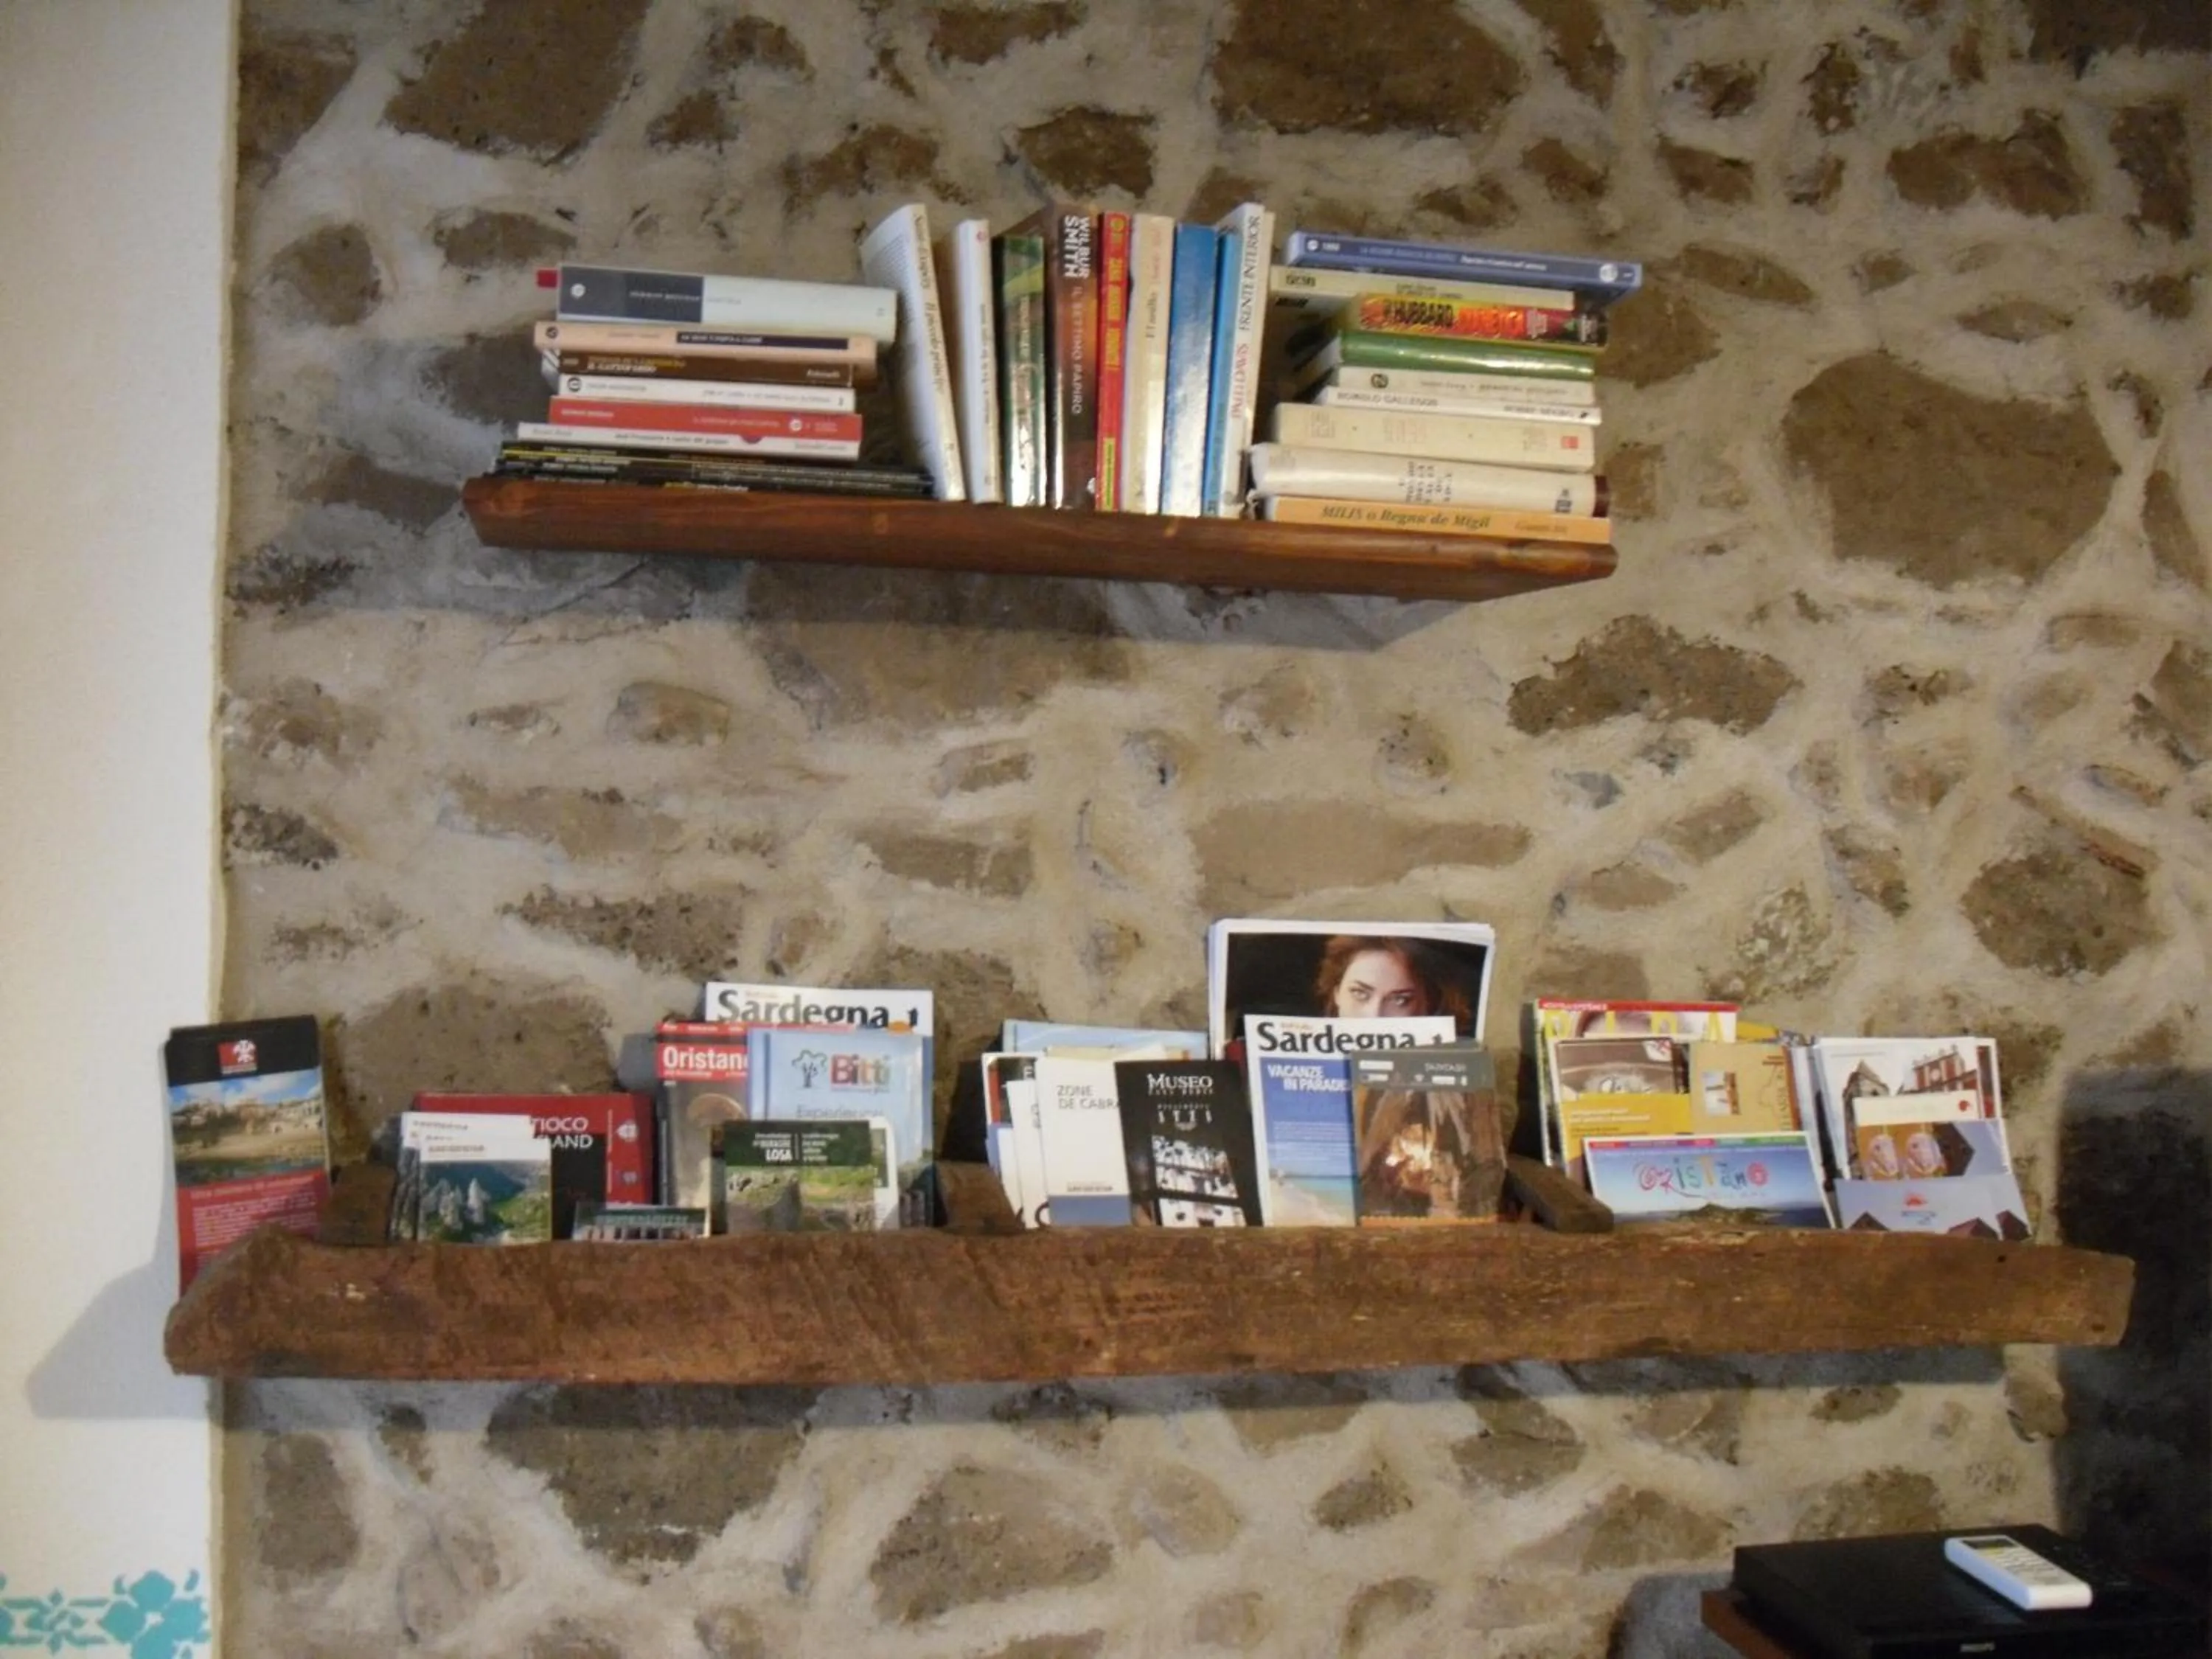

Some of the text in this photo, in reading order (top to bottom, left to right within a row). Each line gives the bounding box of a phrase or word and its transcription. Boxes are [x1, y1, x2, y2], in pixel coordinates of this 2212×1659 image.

[1064, 215, 1079, 277] SMITH
[1079, 216, 1091, 278] WILBUR
[1071, 364, 1083, 414] PAPIRO
[717, 989, 889, 1028] Sardegna
[1256, 1020, 1416, 1054] Sardegna
[663, 1046, 748, 1069] Oristan
[830, 1053, 891, 1085] Bitti
[1266, 1063, 1323, 1078] VACANZE
[1057, 1084, 1094, 1096] ZONE
[1146, 1072, 1214, 1091] MUSEO
[1058, 1097, 1074, 1109] DE
